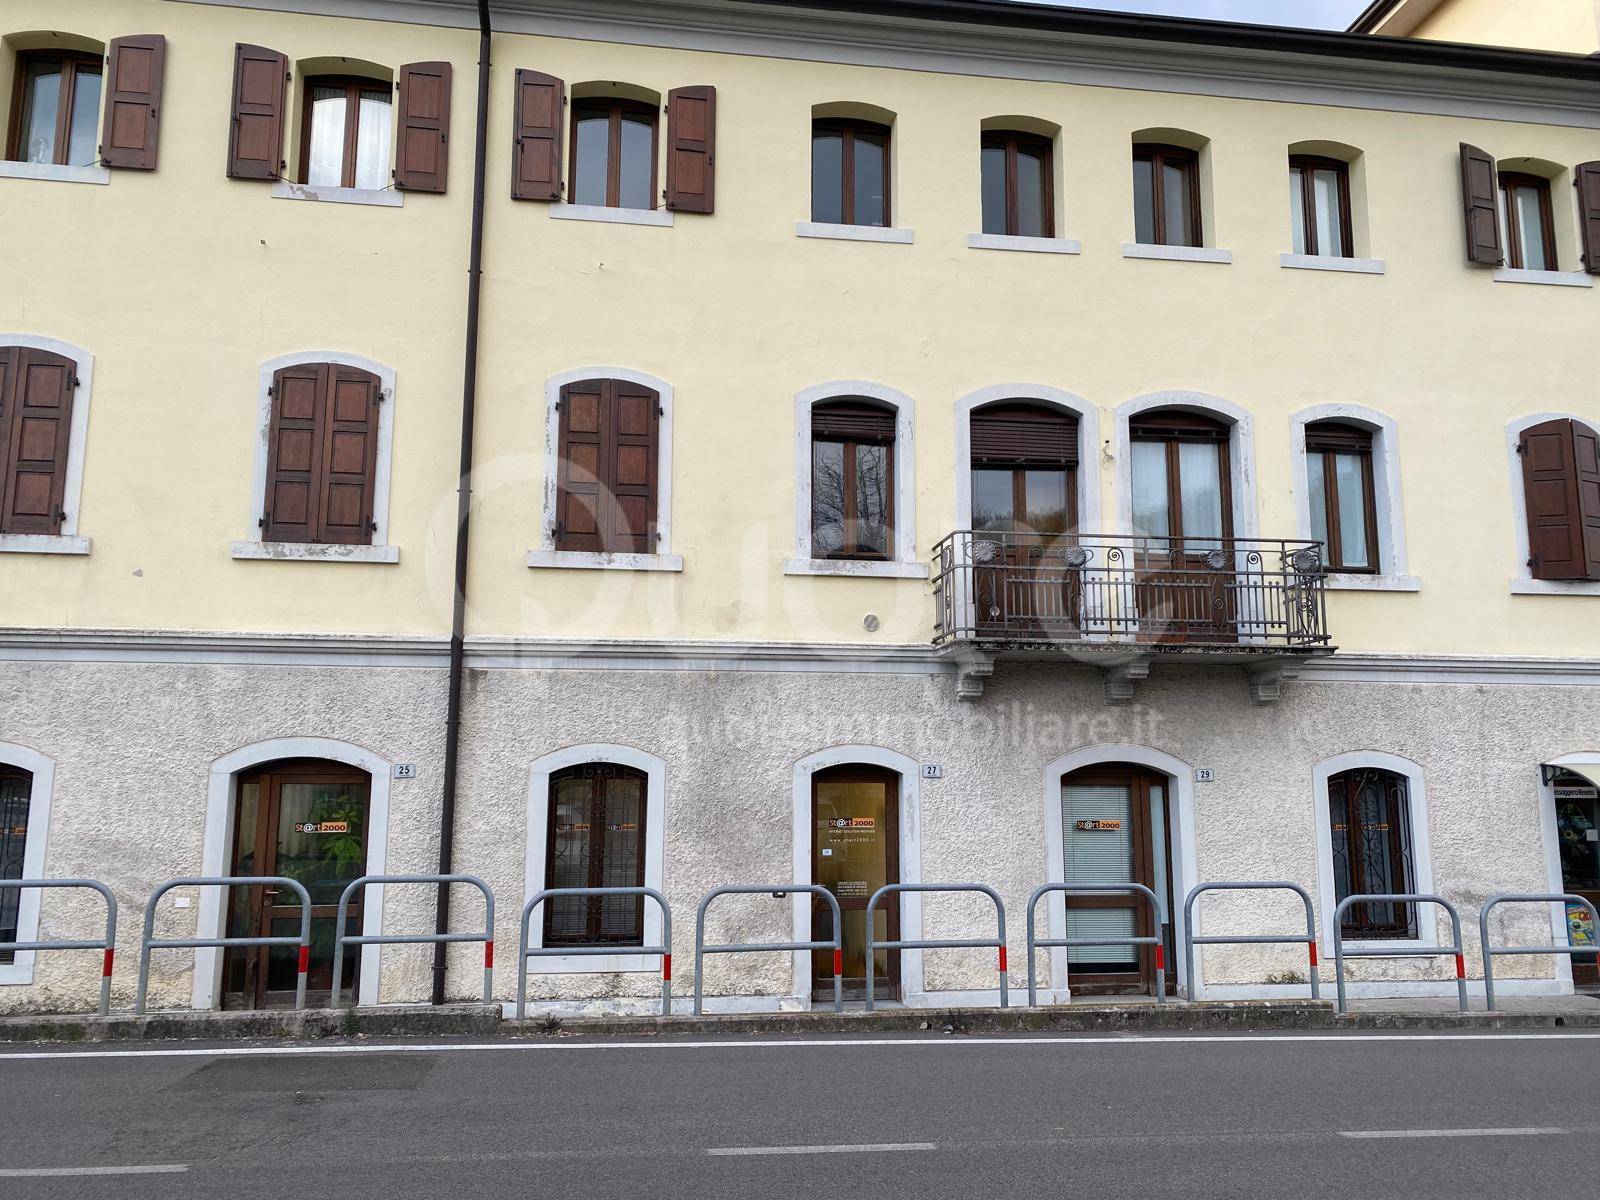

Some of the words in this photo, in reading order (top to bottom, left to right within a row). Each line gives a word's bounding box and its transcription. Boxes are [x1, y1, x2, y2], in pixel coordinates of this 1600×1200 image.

[398, 765, 410, 775] 25
[927, 766, 937, 775] 27
[1200, 770, 1210, 778] 29
[295, 823, 322, 833] St@rt
[324, 824, 346, 832] 2000
[829, 818, 852, 828] St@rt
[1077, 820, 1100, 830] St@rt
